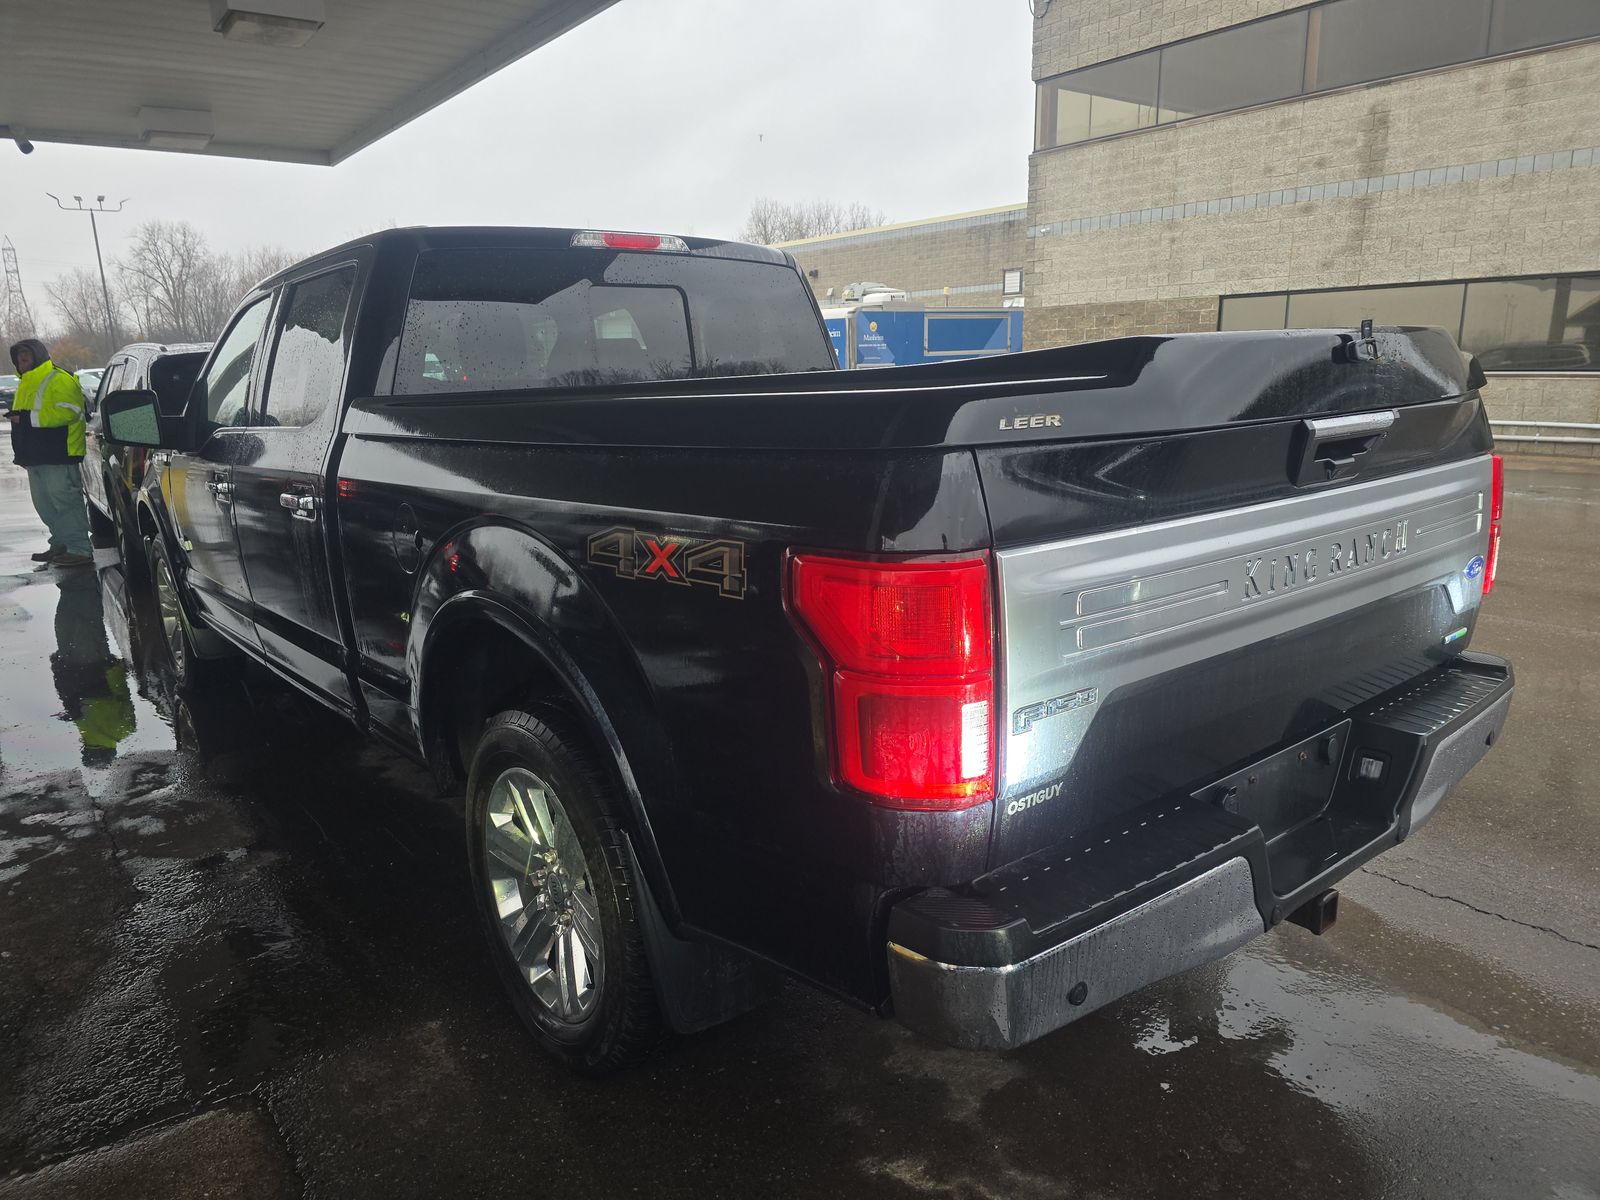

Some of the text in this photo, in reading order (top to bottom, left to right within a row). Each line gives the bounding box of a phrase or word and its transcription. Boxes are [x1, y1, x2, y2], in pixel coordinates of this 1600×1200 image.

[999, 414, 1062, 430] LEER
[1241, 519, 1409, 601] KING RANCH
[1007, 781, 1064, 816] OSTIGUY
